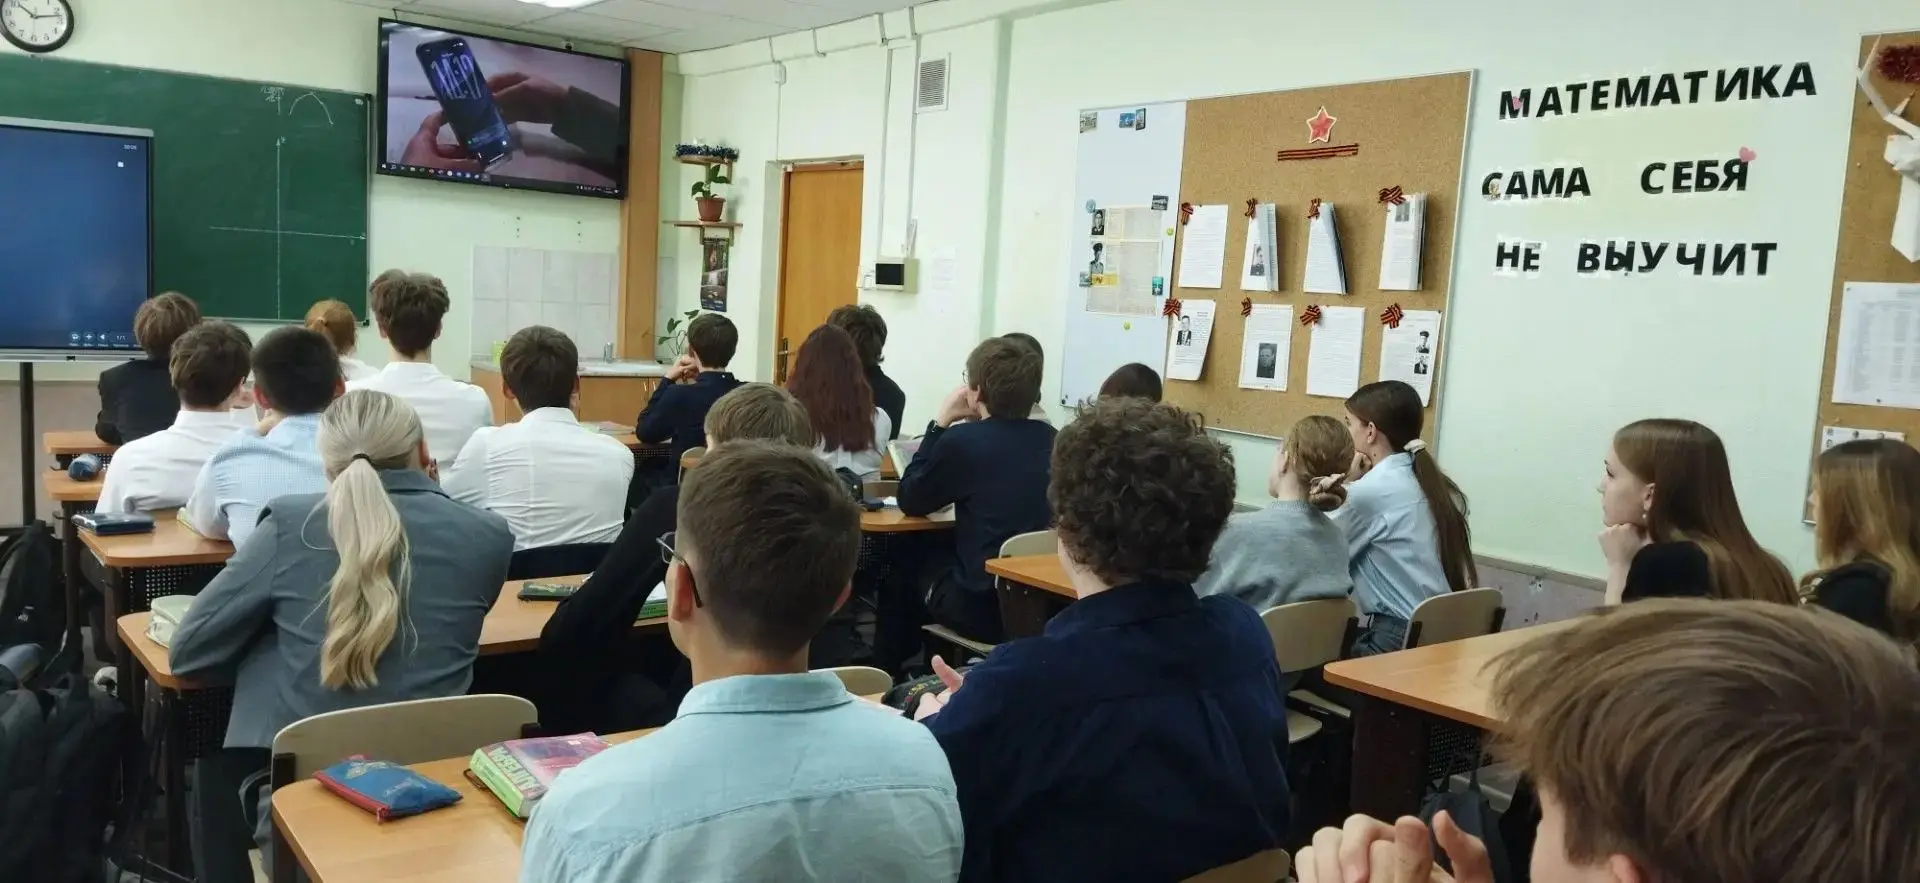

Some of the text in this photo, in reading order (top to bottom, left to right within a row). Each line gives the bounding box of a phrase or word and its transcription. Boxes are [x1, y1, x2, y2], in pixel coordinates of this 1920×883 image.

[1499, 61, 1817, 120] МАТЕМАТИКА
[1481, 157, 1748, 200] САМА СЕБЯ
[1495, 240, 1777, 276] НЕ ВЫУЧИТ
